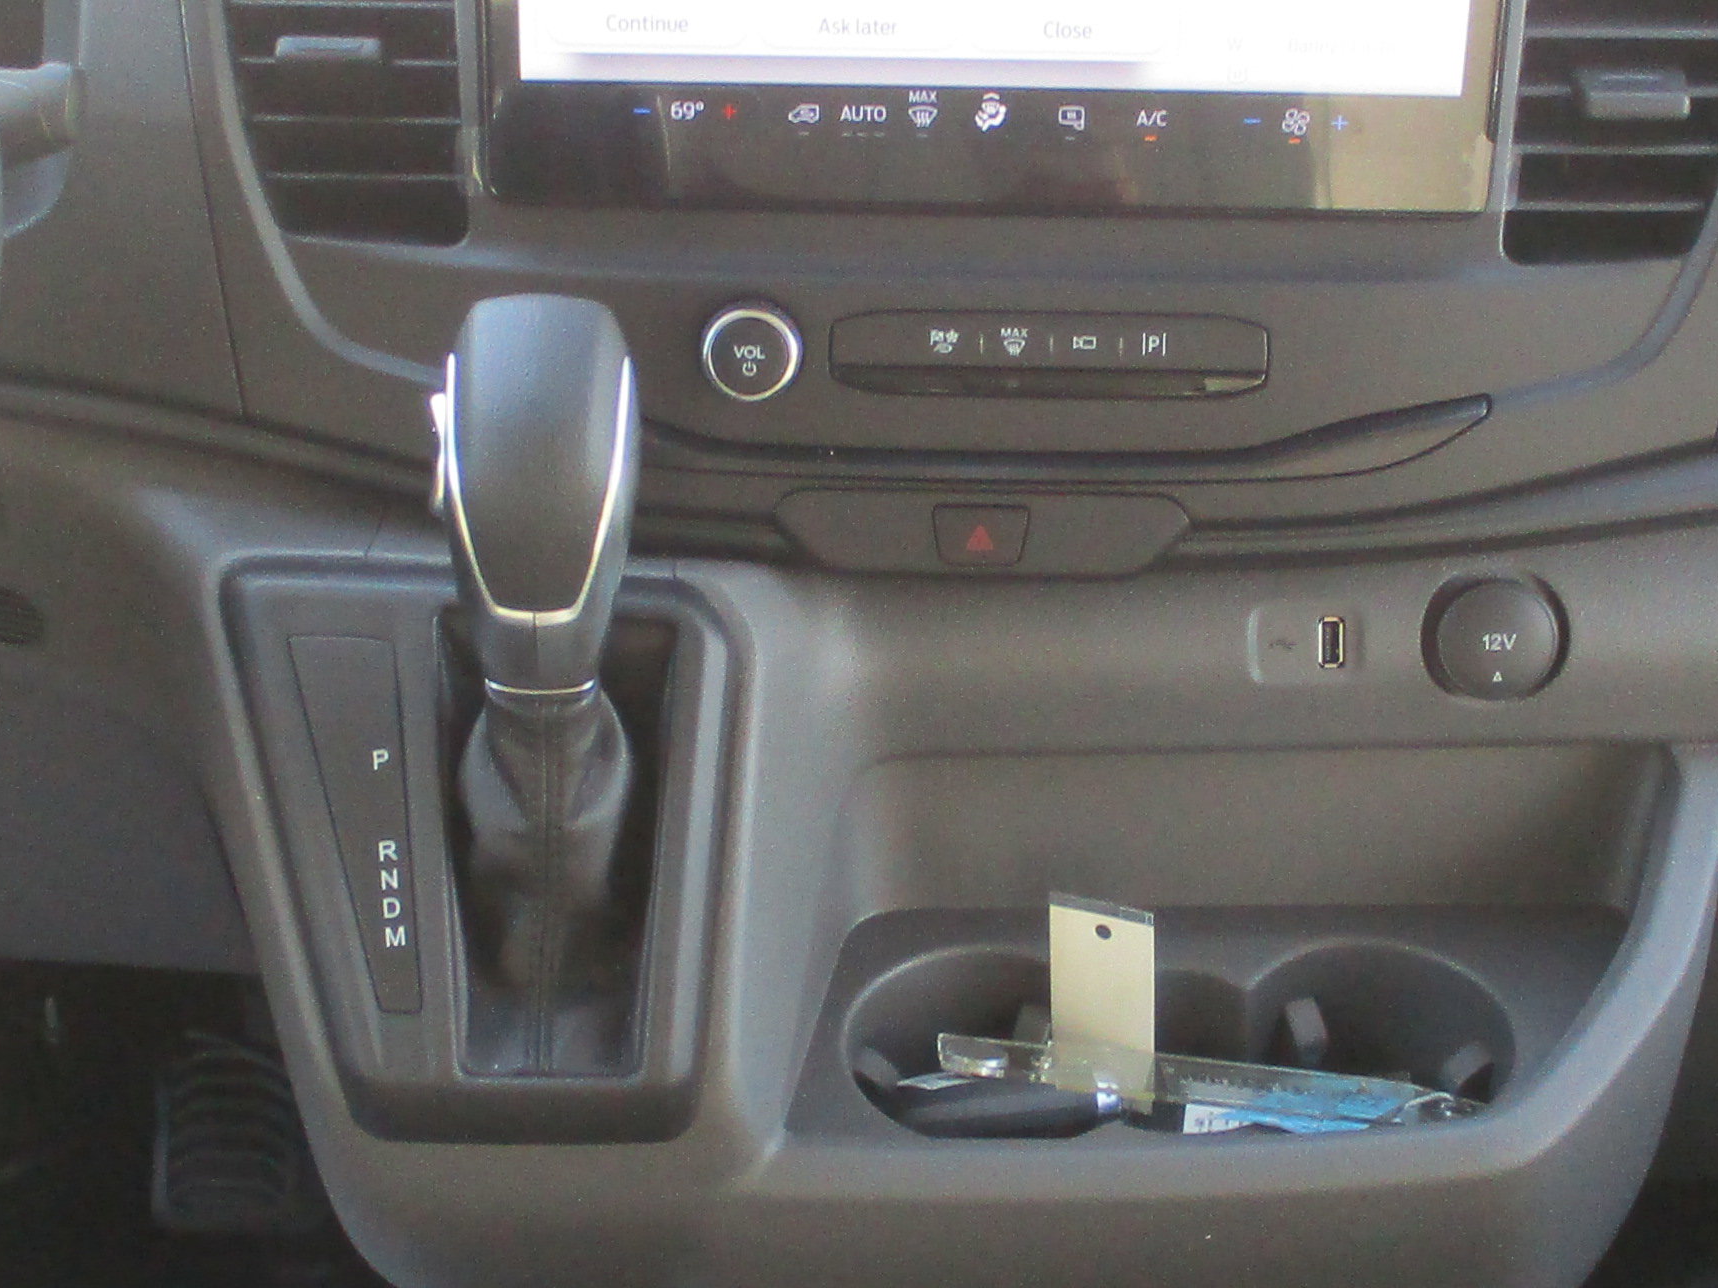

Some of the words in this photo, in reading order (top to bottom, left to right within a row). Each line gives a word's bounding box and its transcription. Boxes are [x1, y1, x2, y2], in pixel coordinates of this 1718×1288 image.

[605, 13, 689, 33] Continue
[818, 17, 850, 35] Ask
[855, 17, 898, 36] later
[1042, 20, 1093, 40] Close
[908, 90, 938, 103] MAX
[840, 103, 888, 122] AUTO
[1136, 109, 1168, 128] A/C
[999, 327, 1030, 339] MAX
[733, 344, 767, 360] VOL
[1482, 632, 1517, 652] 12V
[371, 748, 389, 770] P
[377, 840, 398, 862] R
[380, 869, 399, 890] N
[382, 897, 401, 919] D
[384, 927, 406, 948] M
